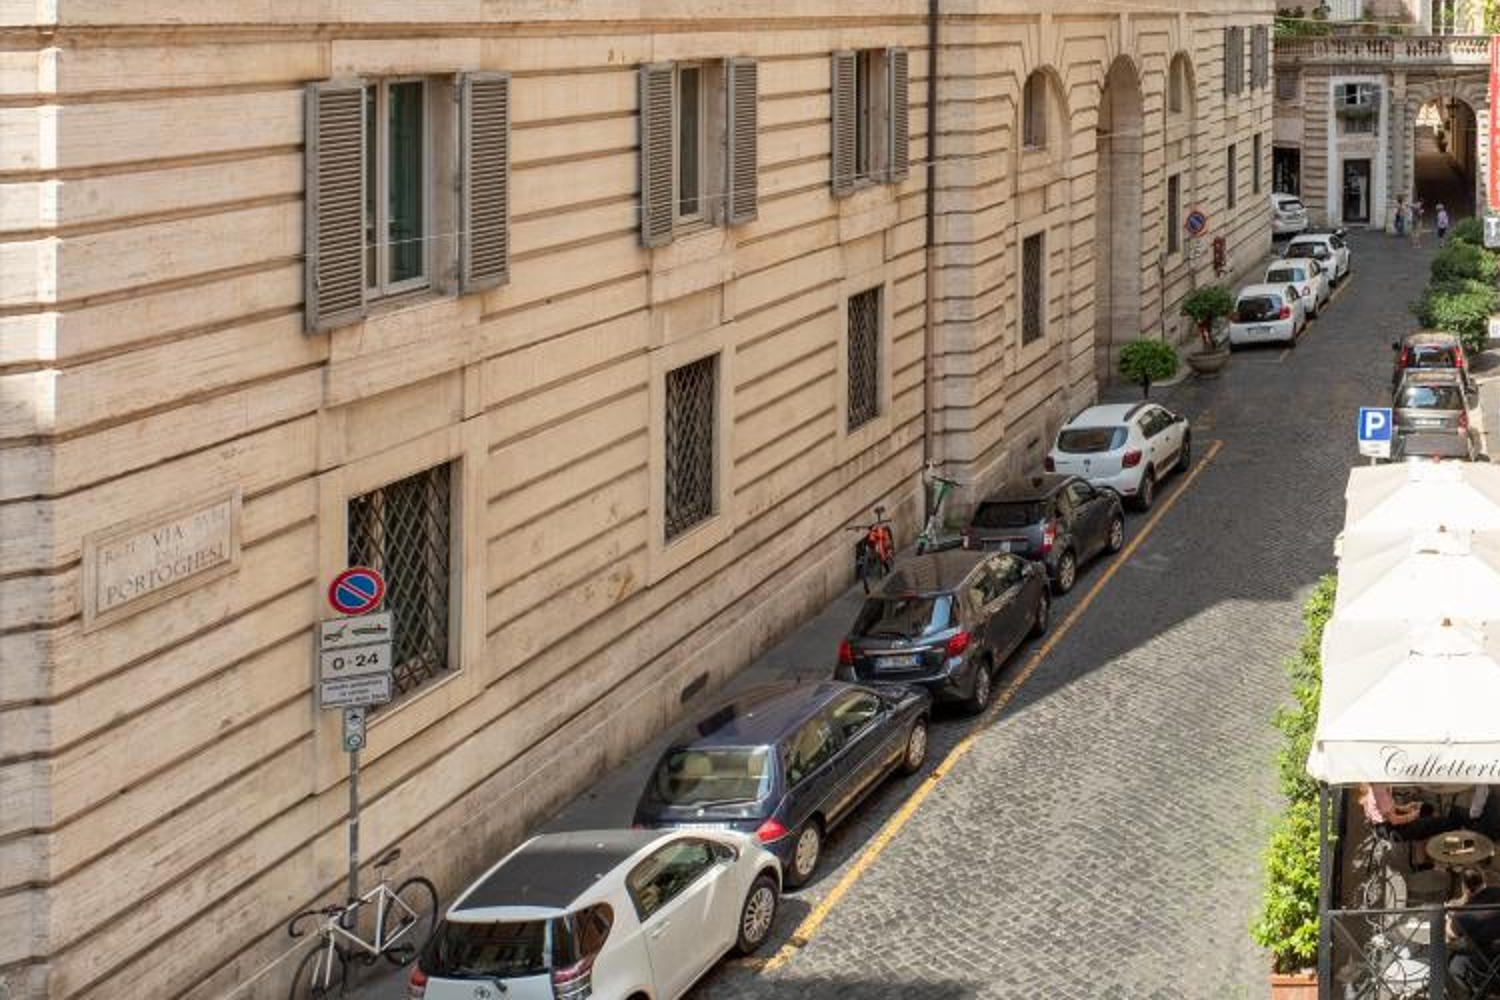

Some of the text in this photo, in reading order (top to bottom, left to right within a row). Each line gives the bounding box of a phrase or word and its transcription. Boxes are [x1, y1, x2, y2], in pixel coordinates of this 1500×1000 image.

[1365, 411, 1385, 438] P
[152, 524, 184, 547] VIA
[106, 541, 225, 605] PORTOGHESI
